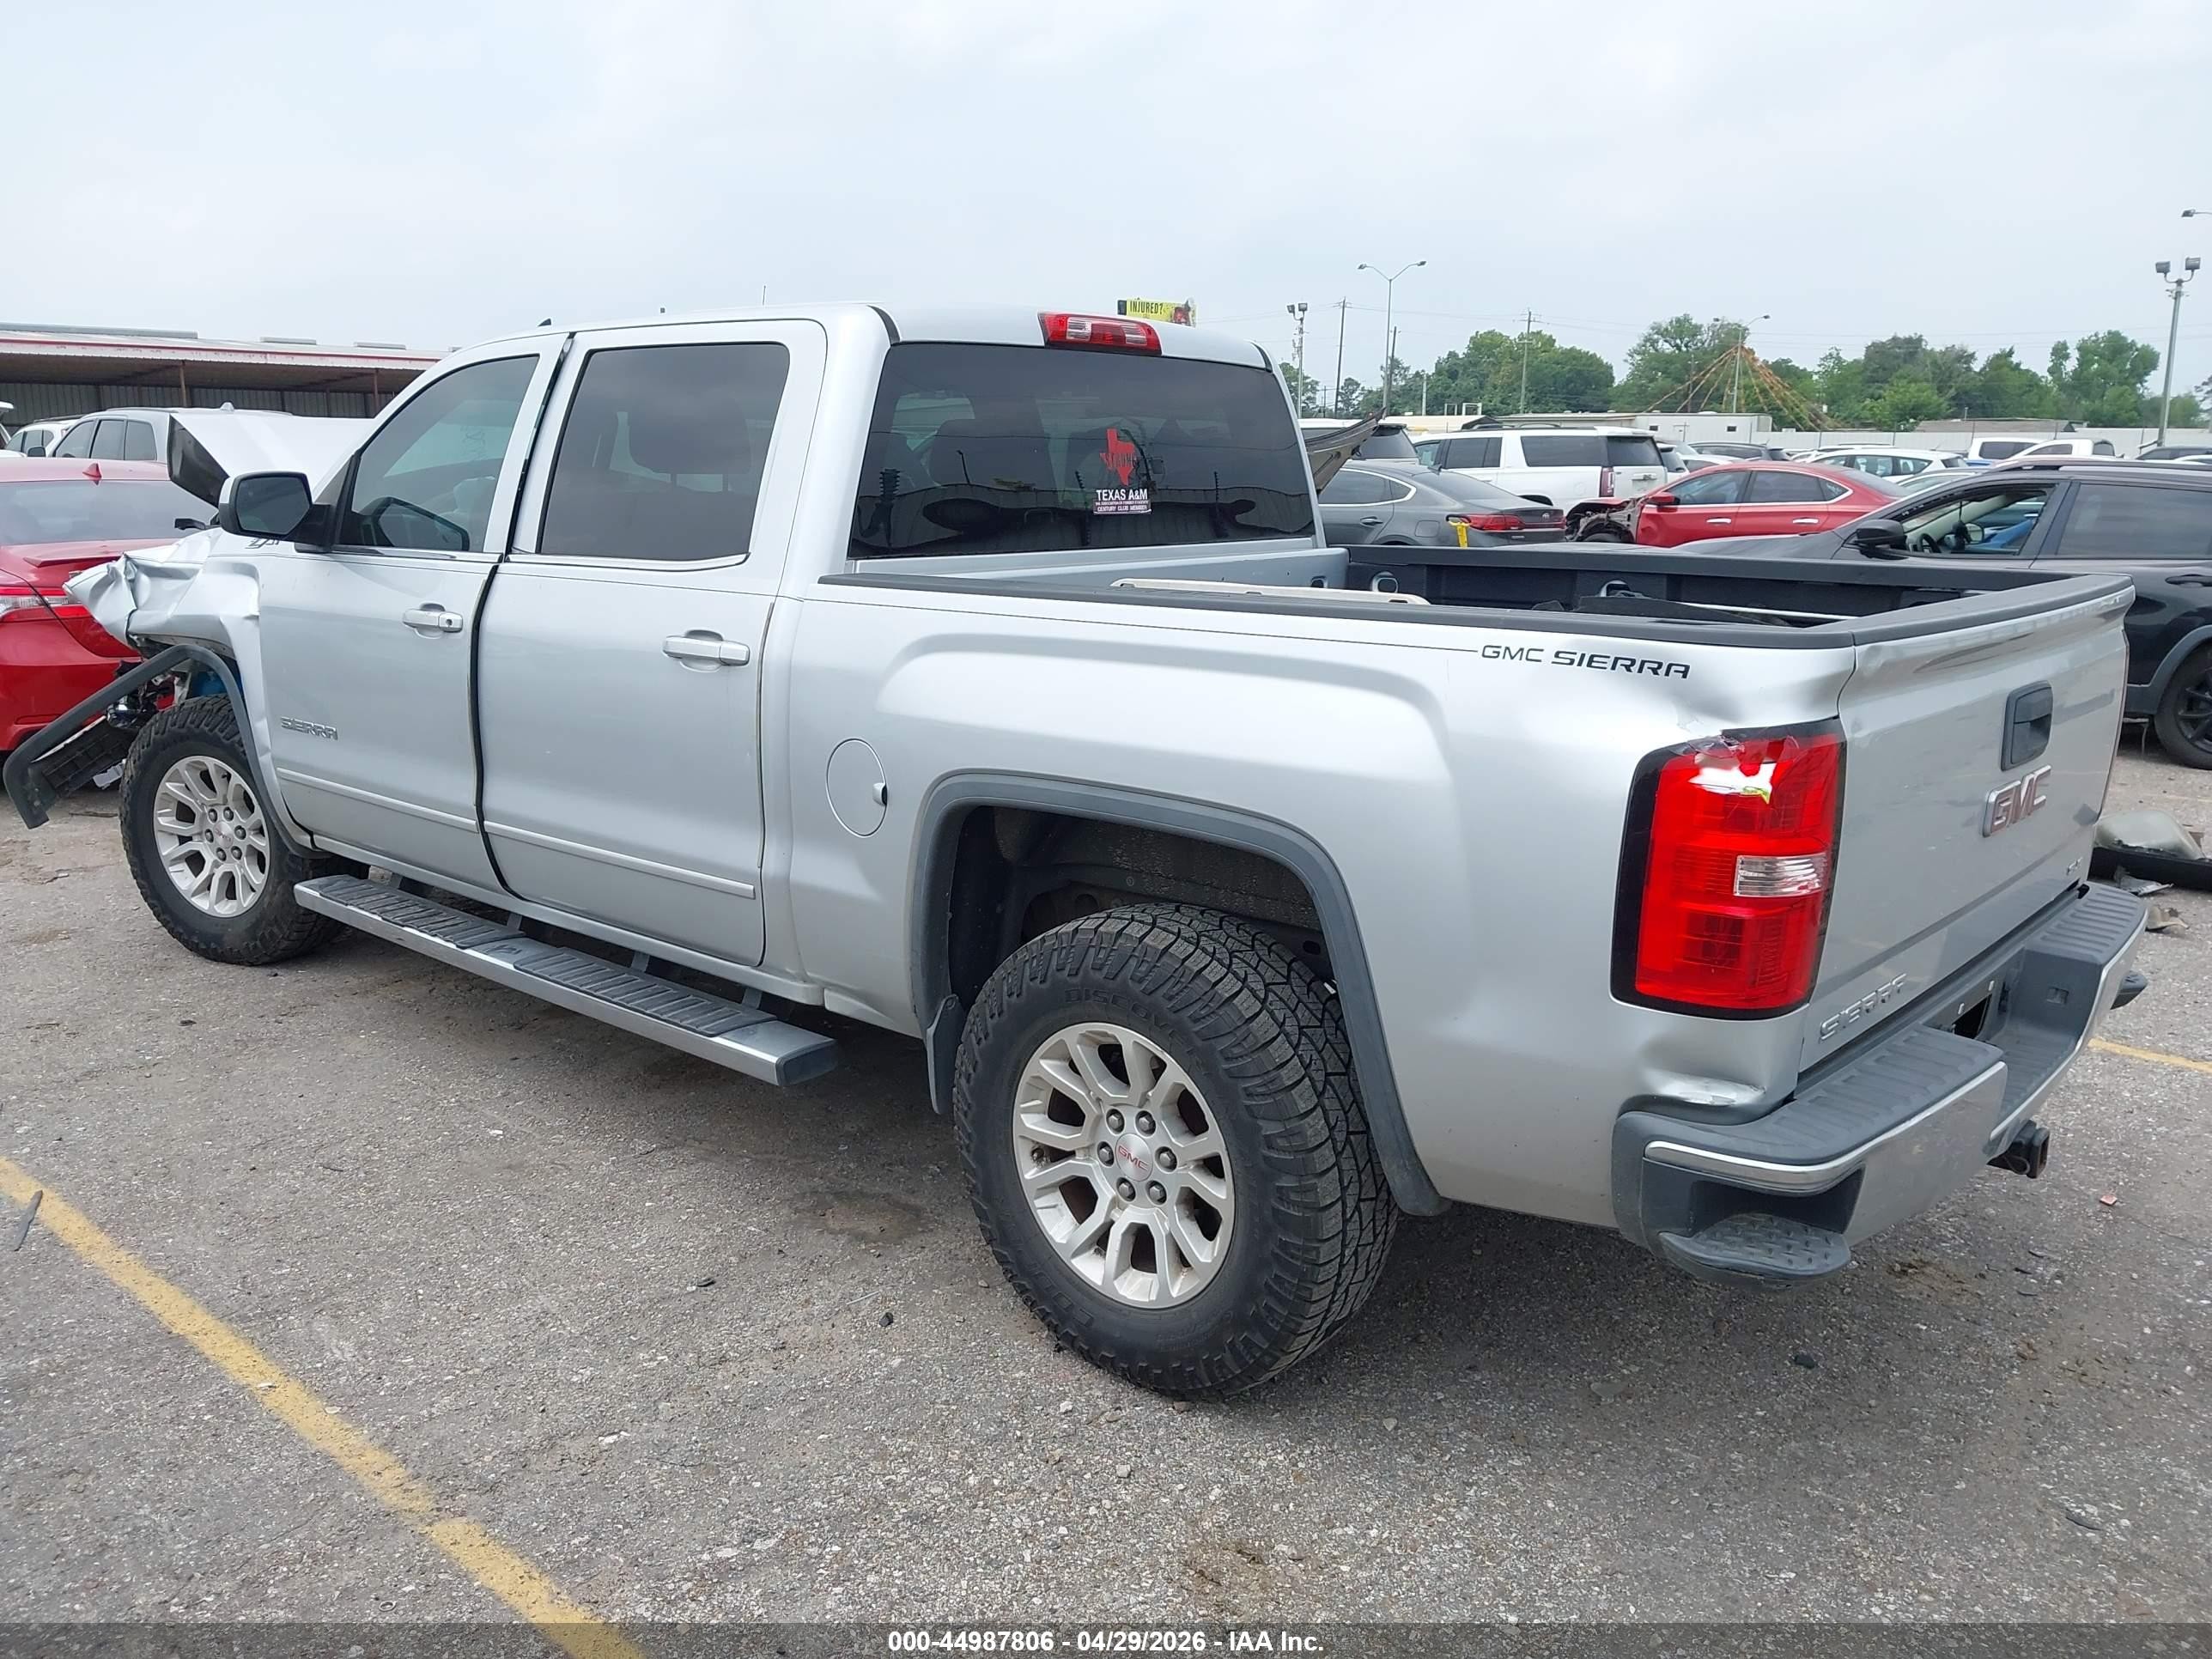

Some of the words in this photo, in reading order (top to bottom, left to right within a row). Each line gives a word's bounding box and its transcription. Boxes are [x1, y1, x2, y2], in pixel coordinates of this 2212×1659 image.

[1129, 301, 1163, 314] INJURED?
[1096, 489, 1126, 501] TEXAS
[1128, 488, 1148, 500] A&M
[1481, 645, 1544, 663] GMC
[1551, 650, 1691, 679] SIERRA
[280, 716, 338, 741] SIERRA
[1983, 764, 2052, 838] GMC
[1118, 1145, 1148, 1171] GMC
